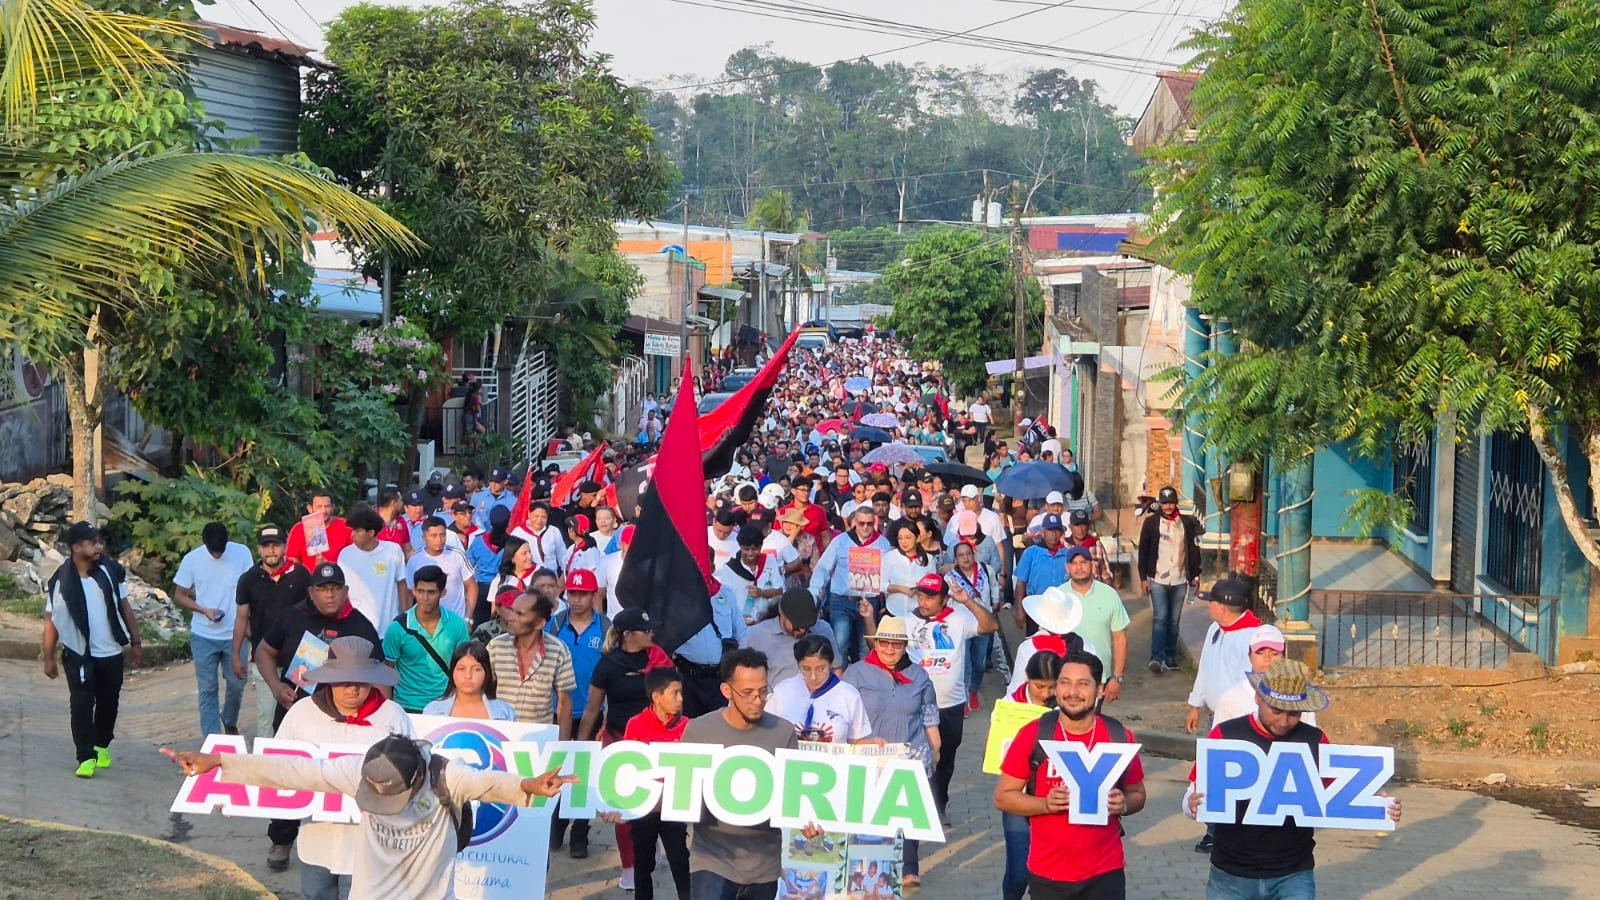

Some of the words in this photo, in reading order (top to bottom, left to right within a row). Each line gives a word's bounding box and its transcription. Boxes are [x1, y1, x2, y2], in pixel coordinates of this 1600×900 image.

[1058, 751, 1122, 814] Y
[1206, 748, 1386, 819] PAZ
[467, 850, 529, 866] CULTURAL
